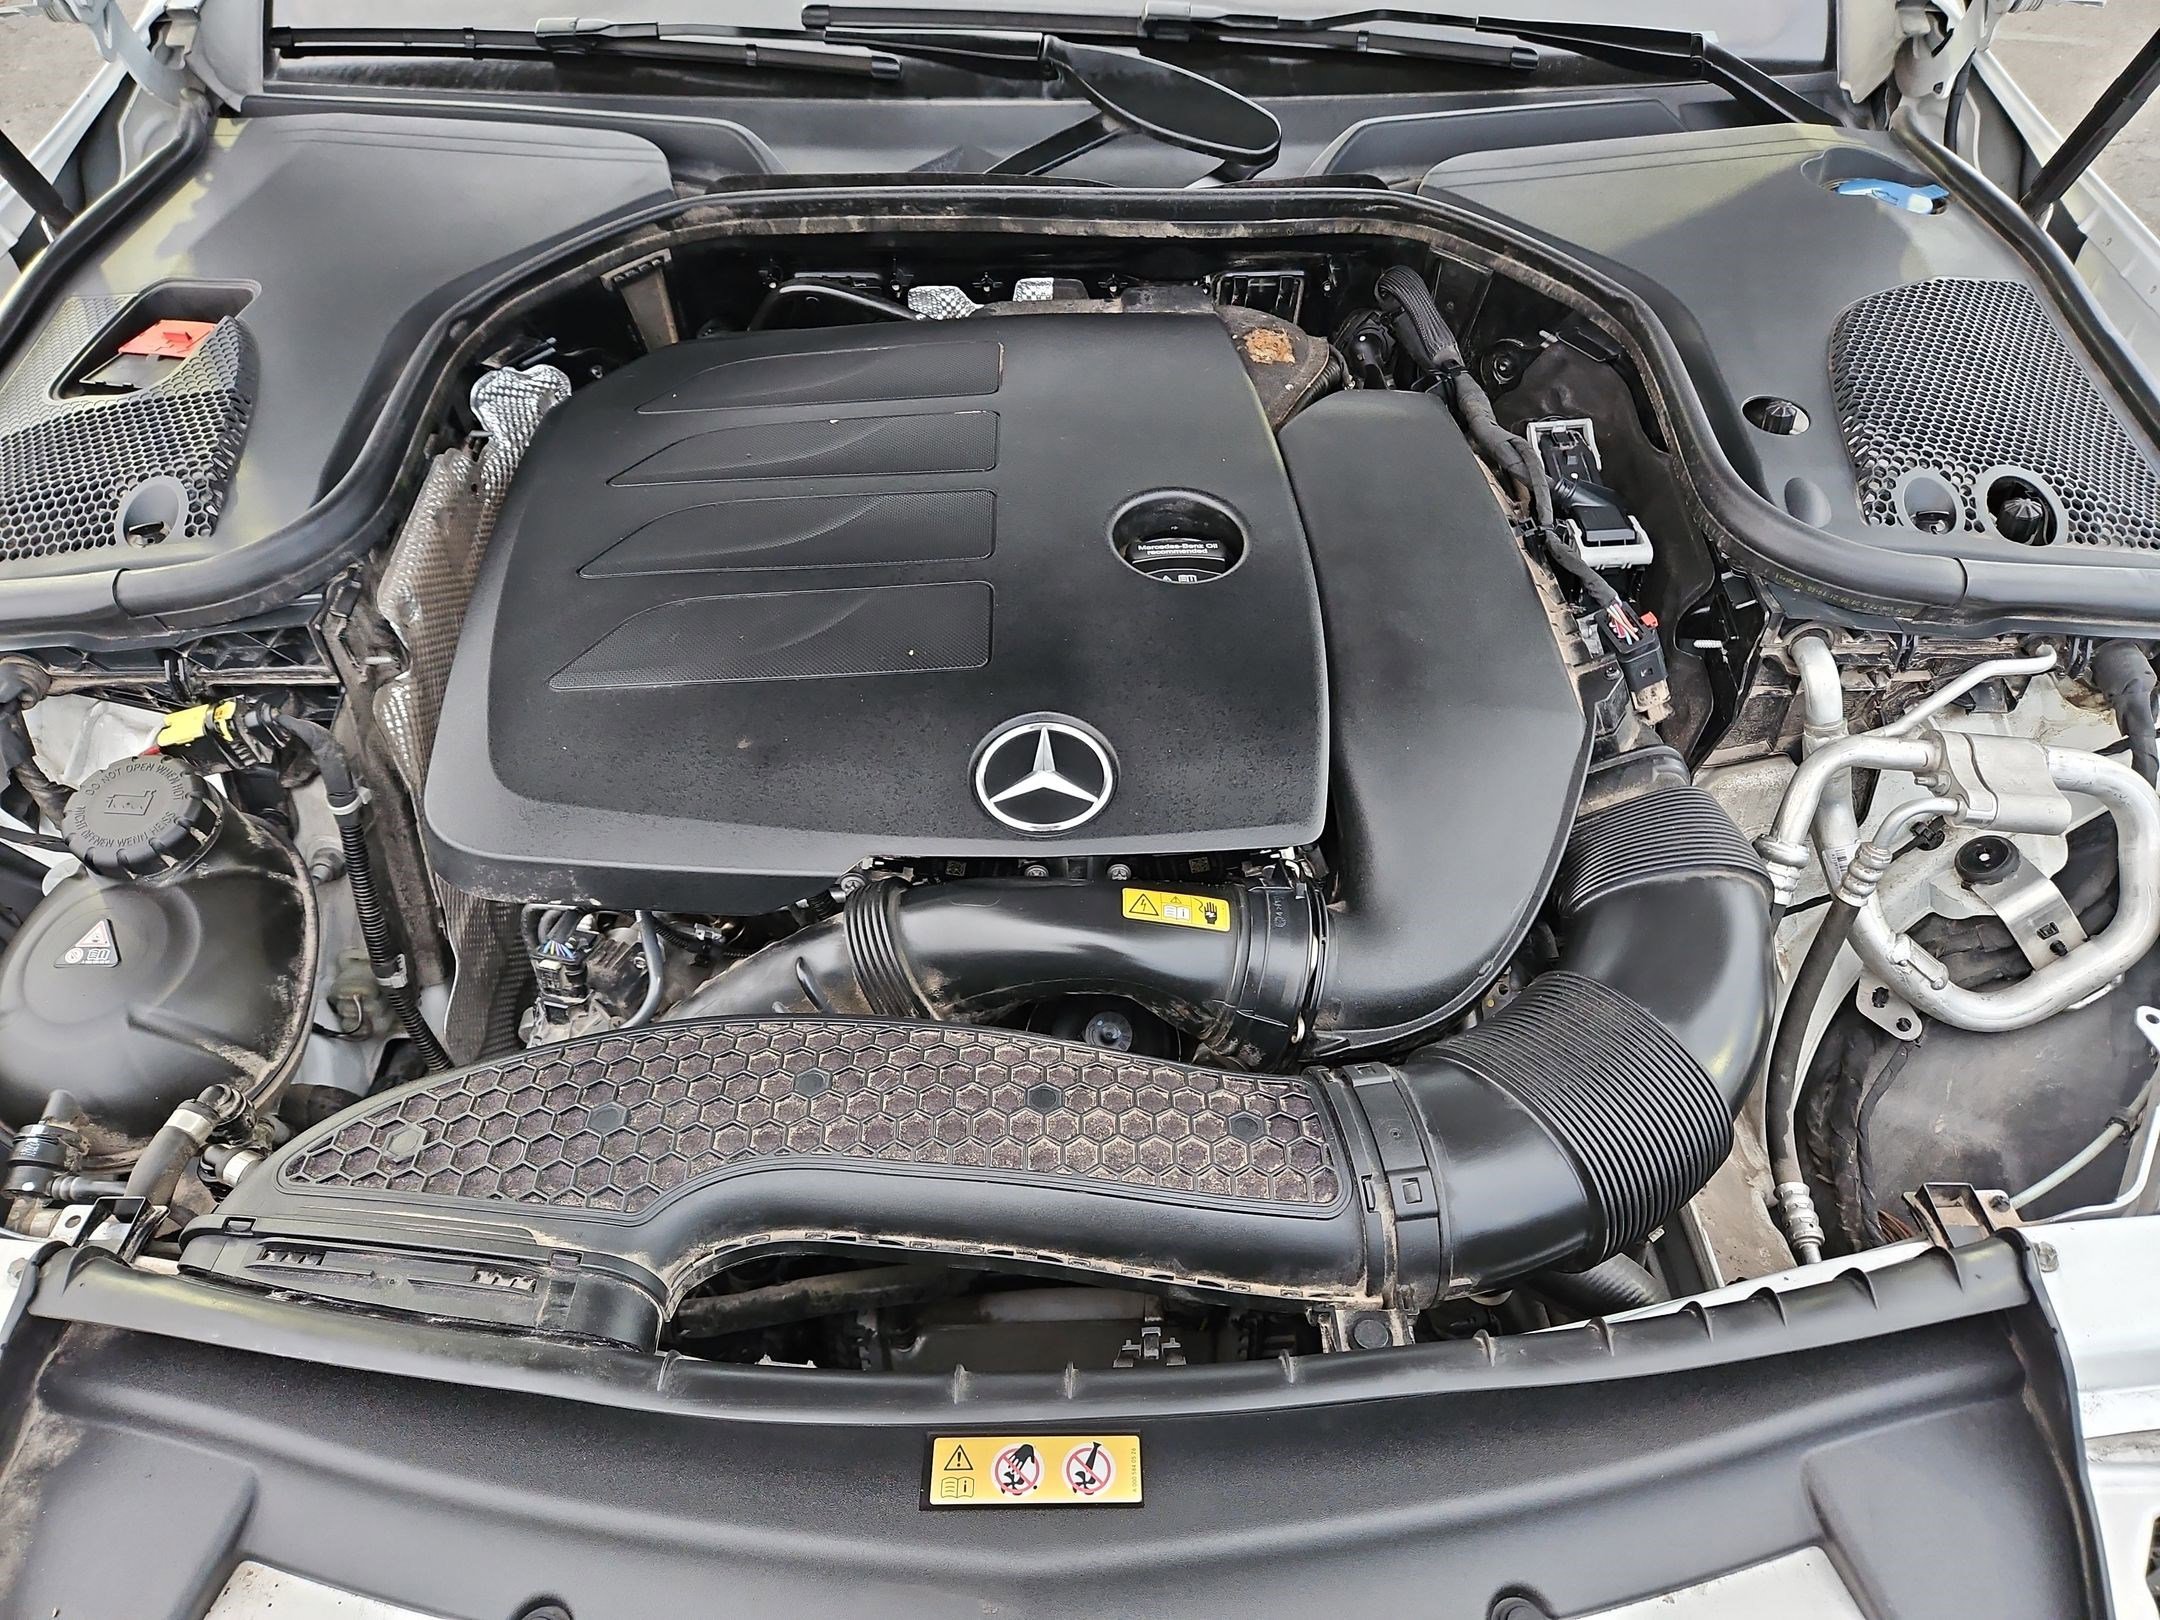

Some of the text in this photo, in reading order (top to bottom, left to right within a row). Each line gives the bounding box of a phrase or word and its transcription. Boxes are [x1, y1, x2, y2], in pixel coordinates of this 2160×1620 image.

[85, 763, 184, 800] DO NOT OPEN WHEN HOT
[117, 832, 148, 847] WENN
